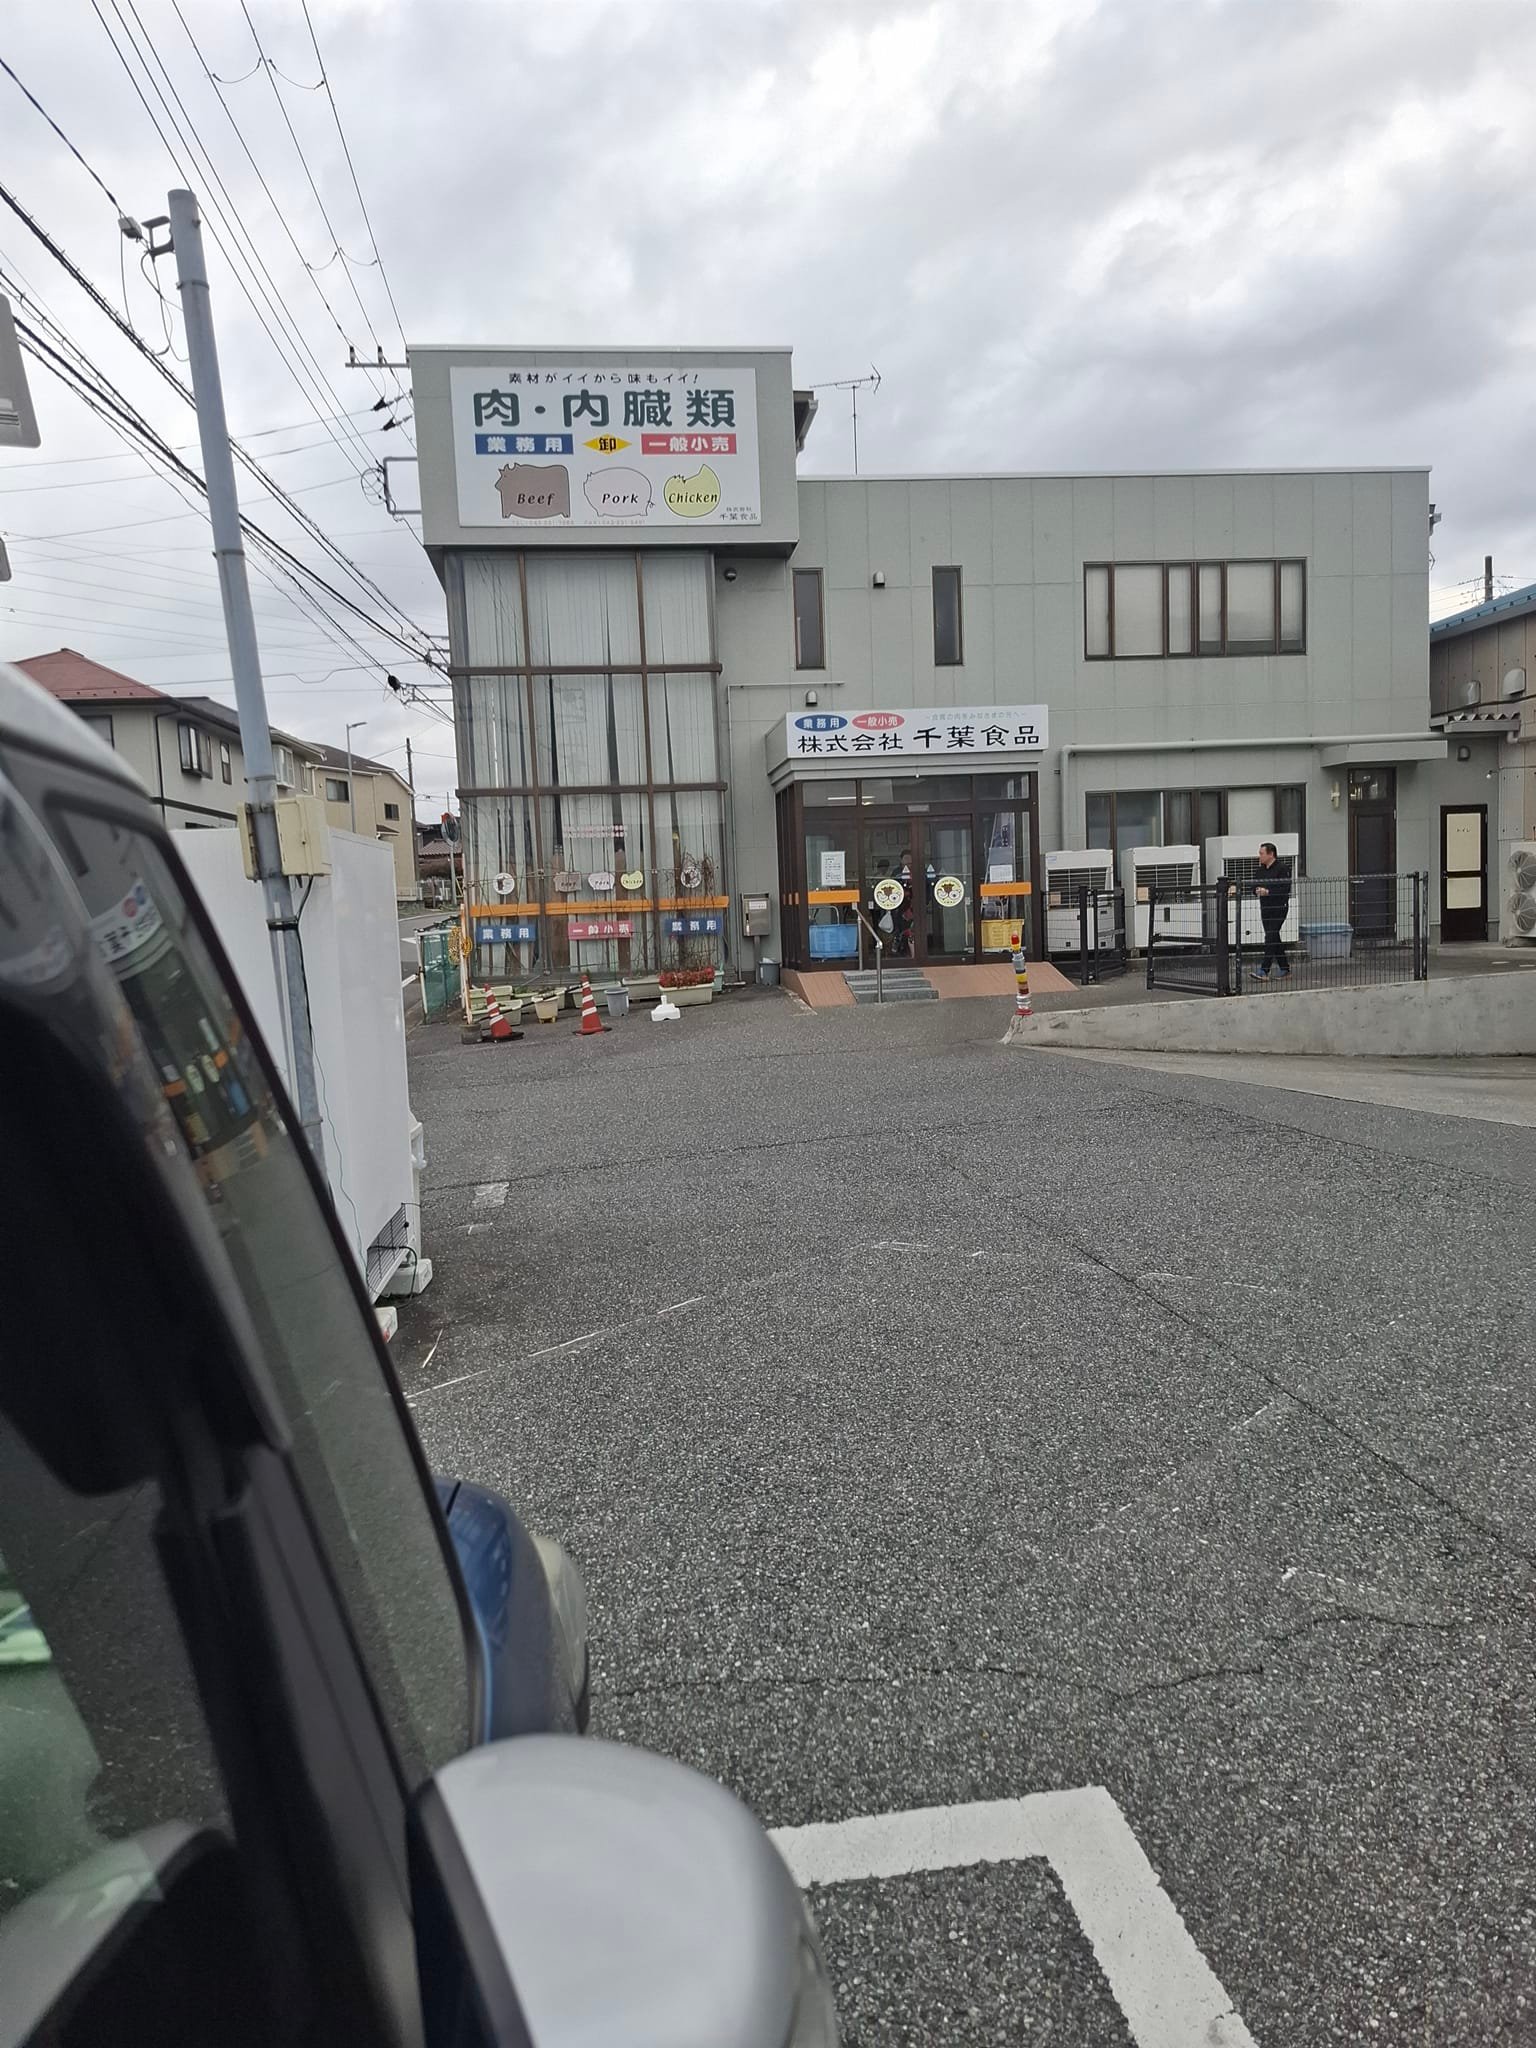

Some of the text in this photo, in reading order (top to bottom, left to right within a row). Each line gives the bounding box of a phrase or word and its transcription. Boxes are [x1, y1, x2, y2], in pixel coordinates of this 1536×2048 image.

[473, 388, 736, 428] 肉・内臓類
[487, 436, 563, 453] 業務用
[599, 436, 617, 453] 卸
[648, 435, 730, 453] 一般小売
[516, 492, 556, 506] Beef
[601, 492, 640, 505] Pork
[668, 491, 719, 504] Chicken
[803, 717, 840, 730] 業務用
[856, 715, 899, 728] 一般小売
[671, 919, 717, 932] 業務用
[482, 927, 530, 940] 業務用
